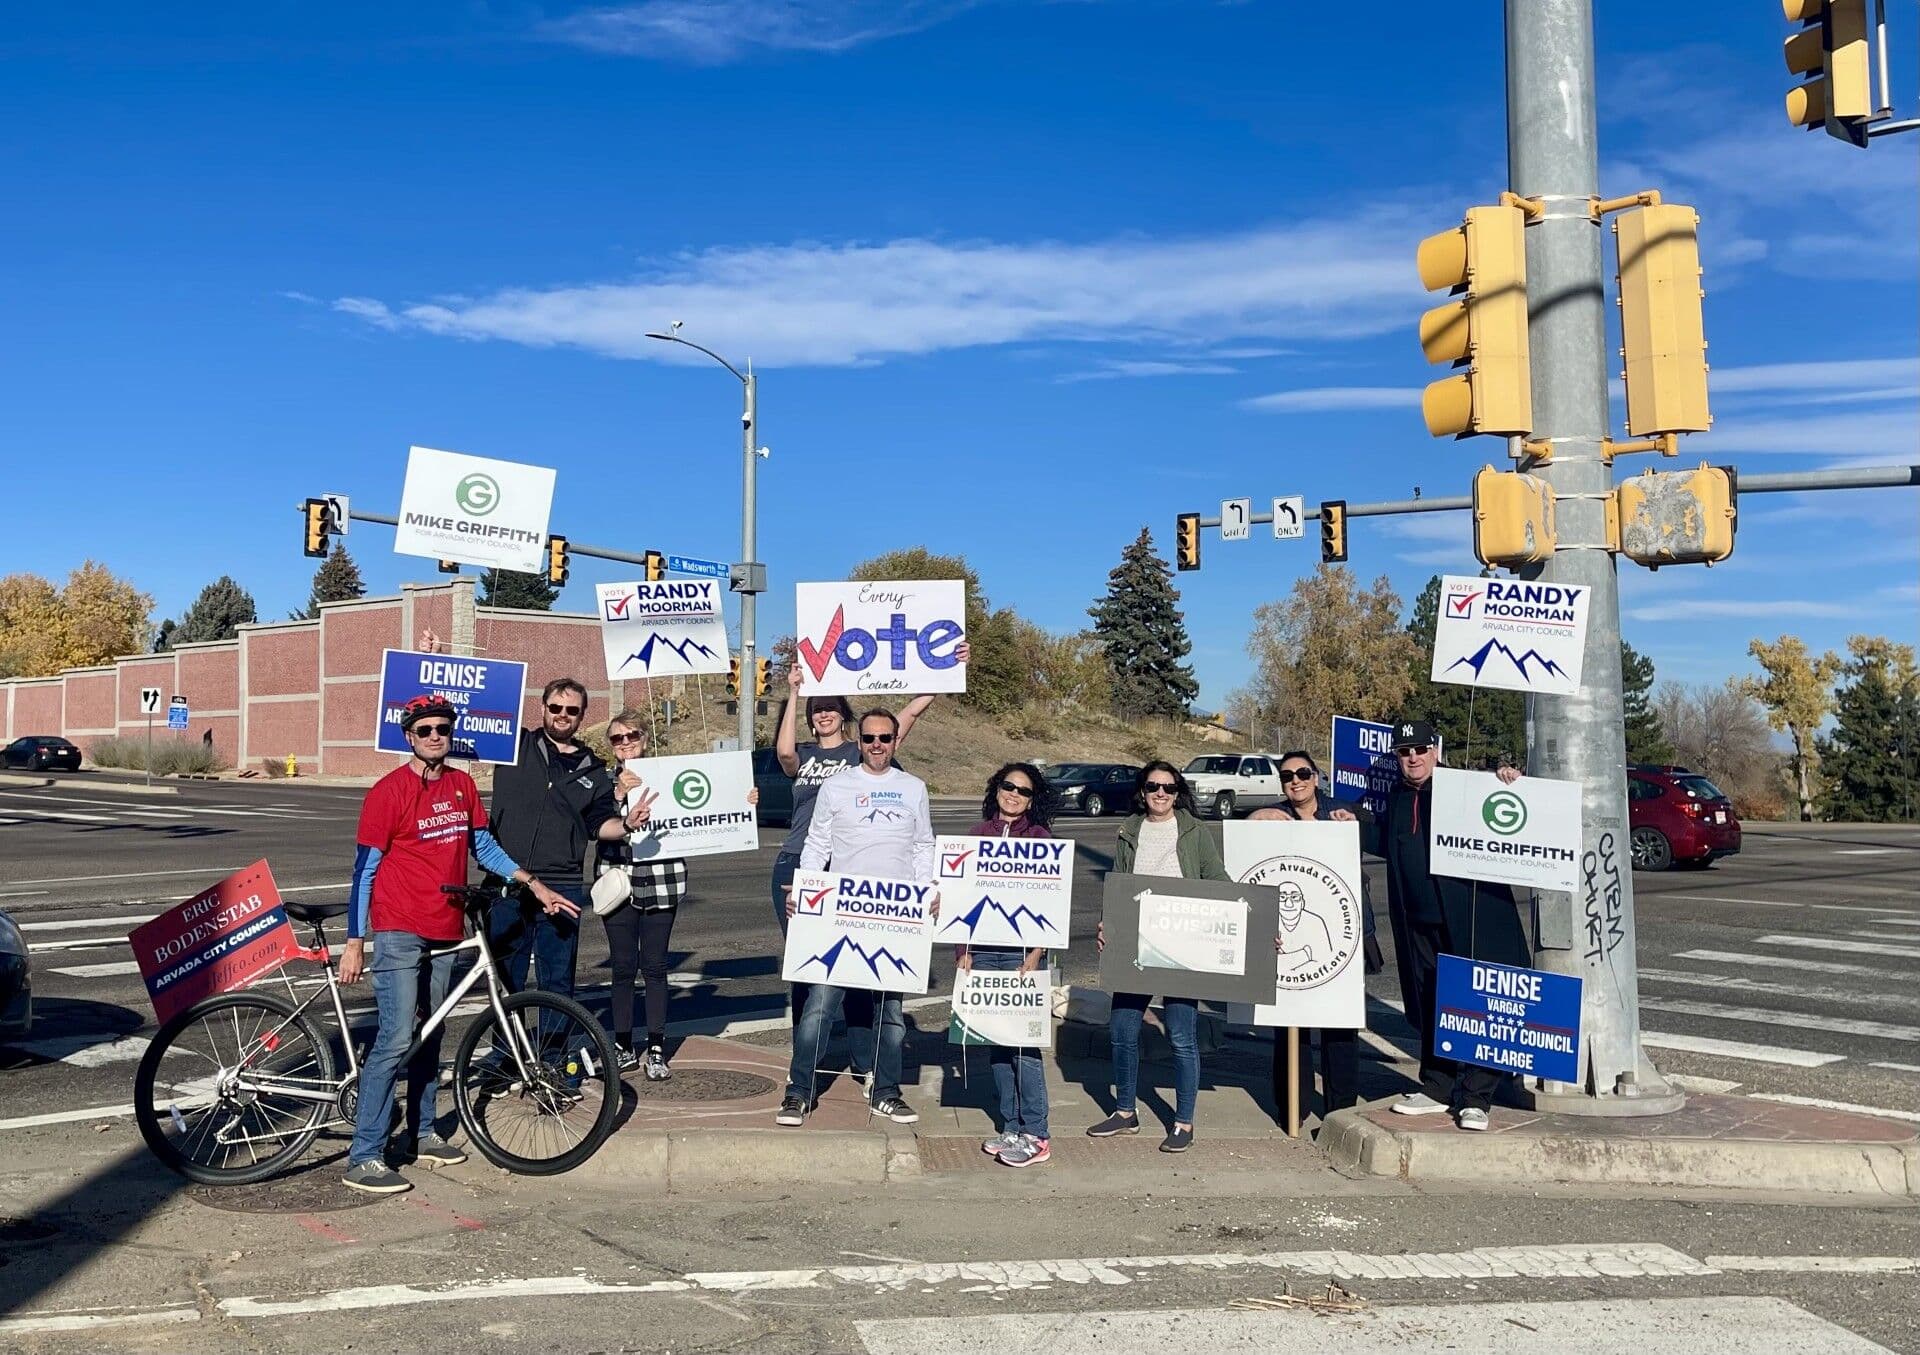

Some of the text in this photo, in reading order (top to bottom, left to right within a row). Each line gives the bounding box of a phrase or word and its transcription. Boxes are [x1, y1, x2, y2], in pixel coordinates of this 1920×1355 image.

[405, 512, 540, 544] MIKE GRIFFITH
[1277, 527, 1299, 536] ONLY
[415, 528, 522, 552] FOR ARVADA CITY COUNCIL
[682, 560, 717, 574] Wadsworth
[604, 582, 712, 600] VOTE RANDY
[858, 583, 916, 609] Every
[1449, 582, 1582, 607] VOTE RANDY
[639, 600, 712, 613] MOORMAN
[1484, 603, 1575, 622] MOORMAN
[641, 617, 716, 627] ARVADA CITY COUNCIL
[1482, 622, 1575, 638] ARVADA CITY COUNCIL
[419, 660, 488, 690] DENISE
[857, 671, 909, 691] Counts
[433, 689, 470, 705] VARGAS
[463, 716, 513, 735] COUNCIL
[1359, 727, 1394, 754] DENI
[1370, 755, 1398, 772] VARGAS
[1336, 769, 1393, 793] ARVADA CITY
[871, 791, 903, 799] RANDY
[1362, 796, 1387, 813] AT-LA
[431, 800, 453, 813] ERIC
[681, 811, 753, 828] GRIFFITH
[692, 828, 708, 836] CITY
[710, 826, 741, 834] COUNCIL
[943, 840, 1067, 861] VOTE RANDY
[1436, 834, 1575, 862] MIKE GRIFFITH
[976, 861, 1061, 875] MOORMAN
[1447, 850, 1558, 870] FOR ARVADA CITY COUNCIL
[802, 877, 930, 904] VOTE RANDY
[975, 880, 1061, 891] ARVADA CITY COUNCIL
[182, 893, 220, 923] ERIC
[836, 899, 923, 919] MOORMAN
[1249, 868, 1267, 886] OFF
[1280, 863, 1319, 878] Arvada
[1321, 875, 1341, 896] City
[1338, 897, 1353, 940] Council
[153, 894, 263, 964] BODENSTAB
[834, 919, 923, 936] ARVADA CITY COUNCIL
[155, 958, 203, 989] ARVADA
[203, 941, 227, 961] CITY
[229, 914, 279, 946] COUNCIL
[1277, 950, 1348, 983] ronSkoff.org
[971, 975, 1036, 989] REBECKA
[1472, 965, 1543, 1002] DENISE
[960, 991, 1044, 1007] LOVISONE
[1487, 998, 1526, 1017] VARGAS
[1439, 1012, 1574, 1054] ARVADA CITY COUNCIL
[1474, 1043, 1534, 1070] AT-LARGE
